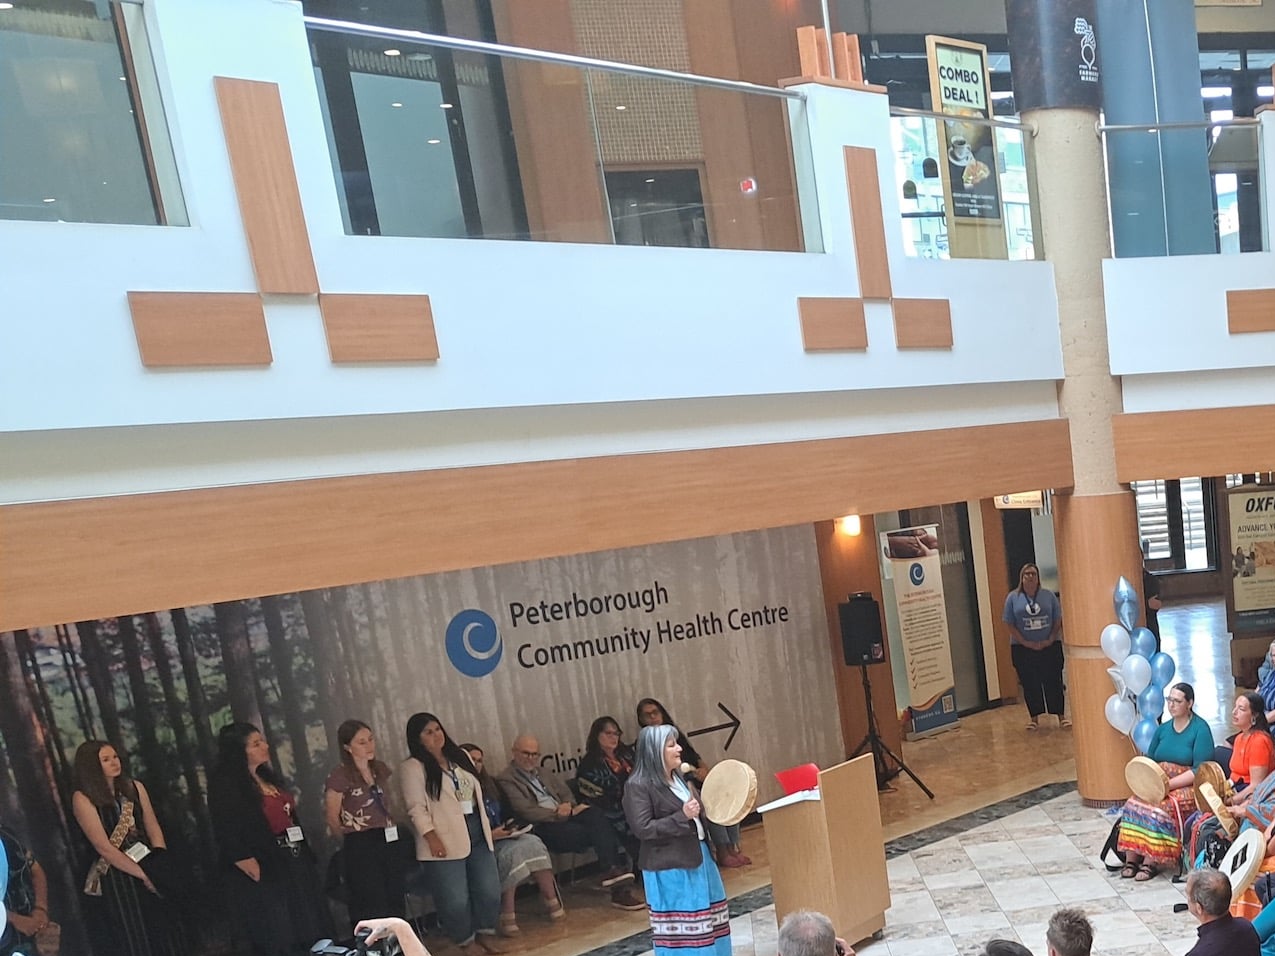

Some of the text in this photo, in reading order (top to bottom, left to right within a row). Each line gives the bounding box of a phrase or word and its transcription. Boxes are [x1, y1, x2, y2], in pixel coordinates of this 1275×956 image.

[939, 65, 979, 84] COMBO
[943, 86, 973, 103] DEAL
[1237, 523, 1268, 533] ADVANCE
[509, 580, 669, 628] Peterborough
[517, 604, 789, 669] Community Health Centre
[540, 748, 583, 774] Clini
